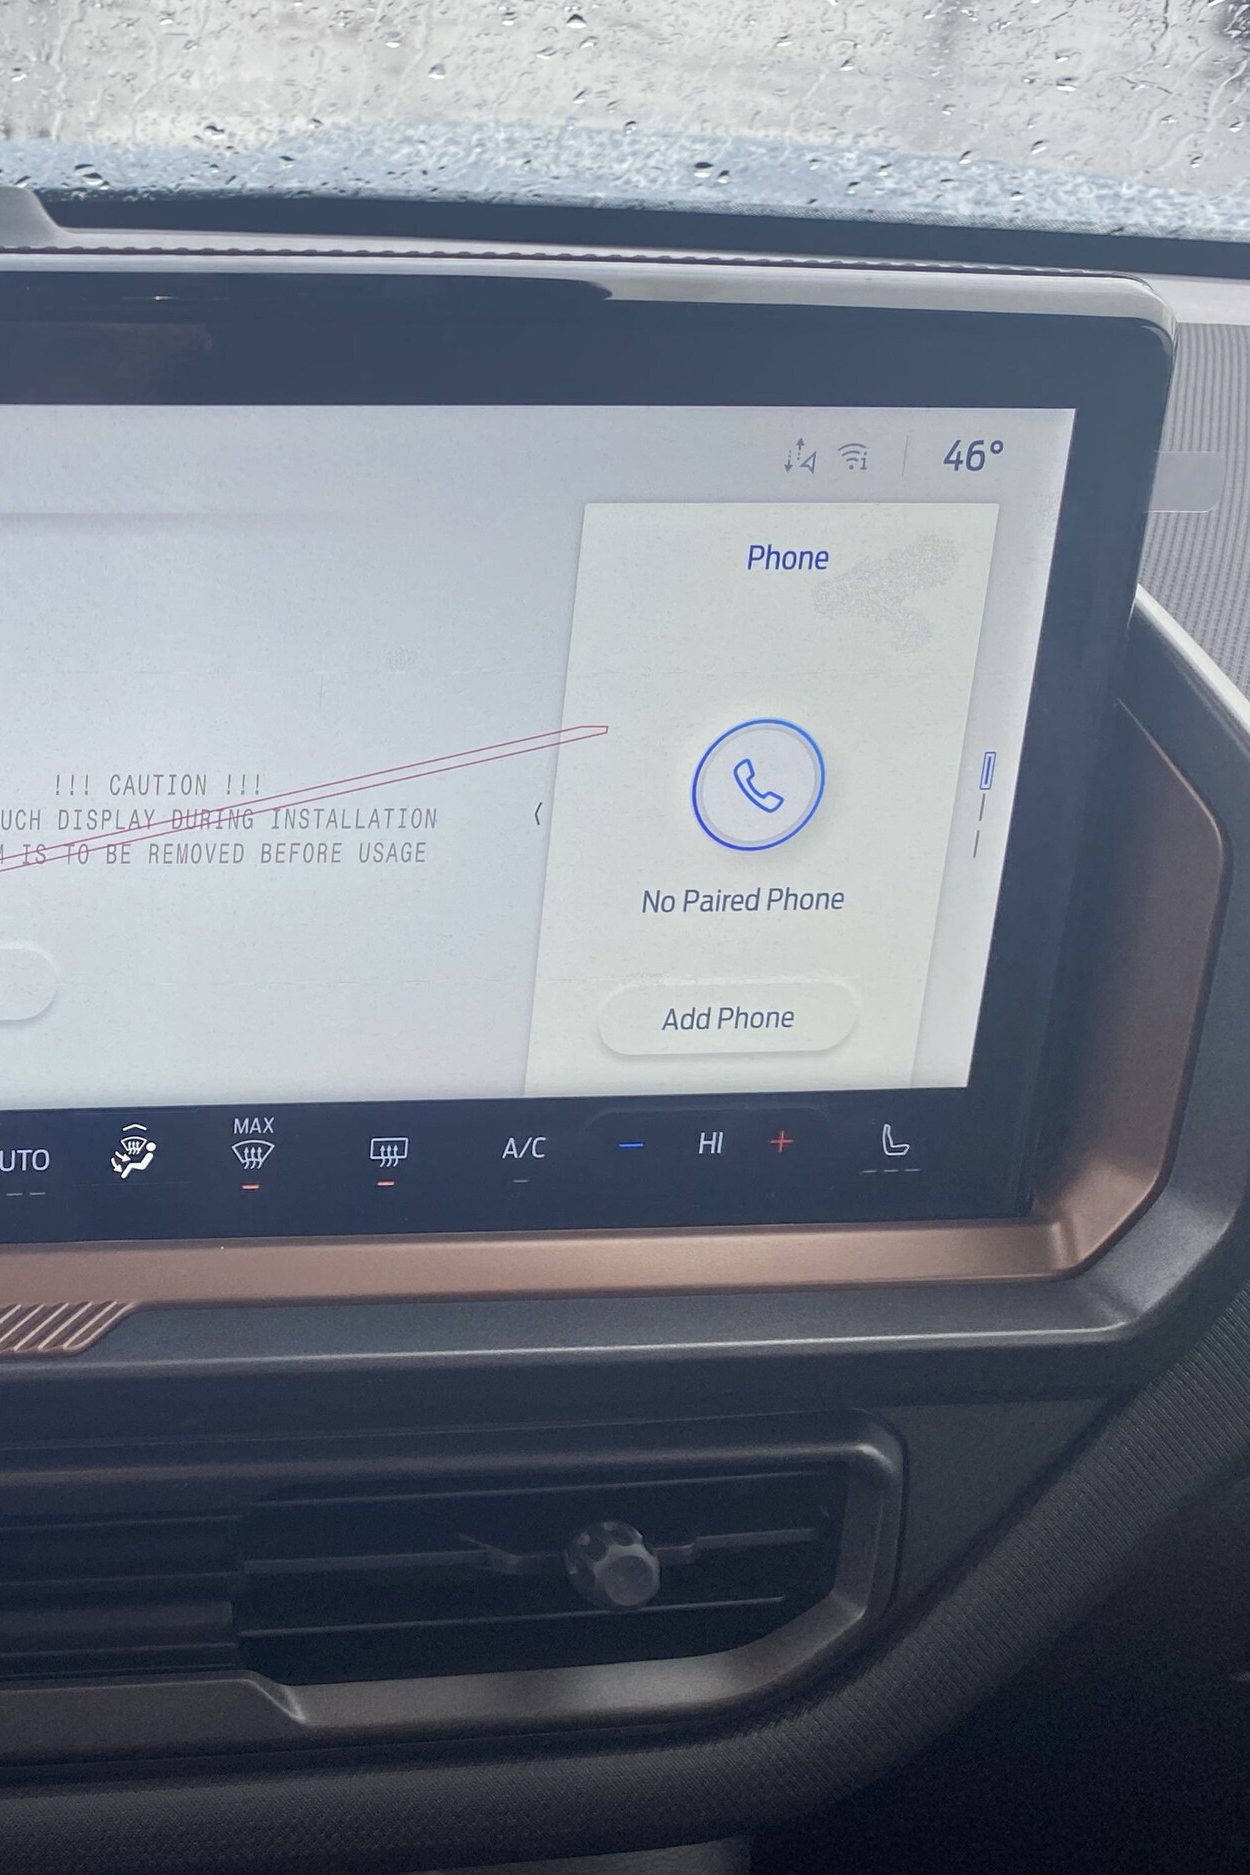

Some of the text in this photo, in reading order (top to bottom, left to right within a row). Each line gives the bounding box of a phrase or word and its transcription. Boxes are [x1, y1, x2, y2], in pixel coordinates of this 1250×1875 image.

[943, 439, 1004, 472] 46°
[747, 543, 830, 571] Phone
[109, 773, 208, 796] CAUTION
[57, 808, 156, 831] DISPLAY
[171, 808, 255, 830] DURING
[270, 807, 438, 830] INSTALLATION
[22, 843, 48, 866] IS
[63, 843, 90, 865] TO
[105, 843, 132, 865] BE
[148, 842, 245, 865] REMOVED
[260, 842, 343, 864] BEFORE
[358, 841, 427, 864] USAGE
[642, 887, 845, 914] No Paired Phone
[661, 1006, 795, 1031] Add Phone
[233, 1116, 275, 1135] MAX
[502, 1136, 547, 1159] A/C
[698, 1131, 724, 1155] HI
